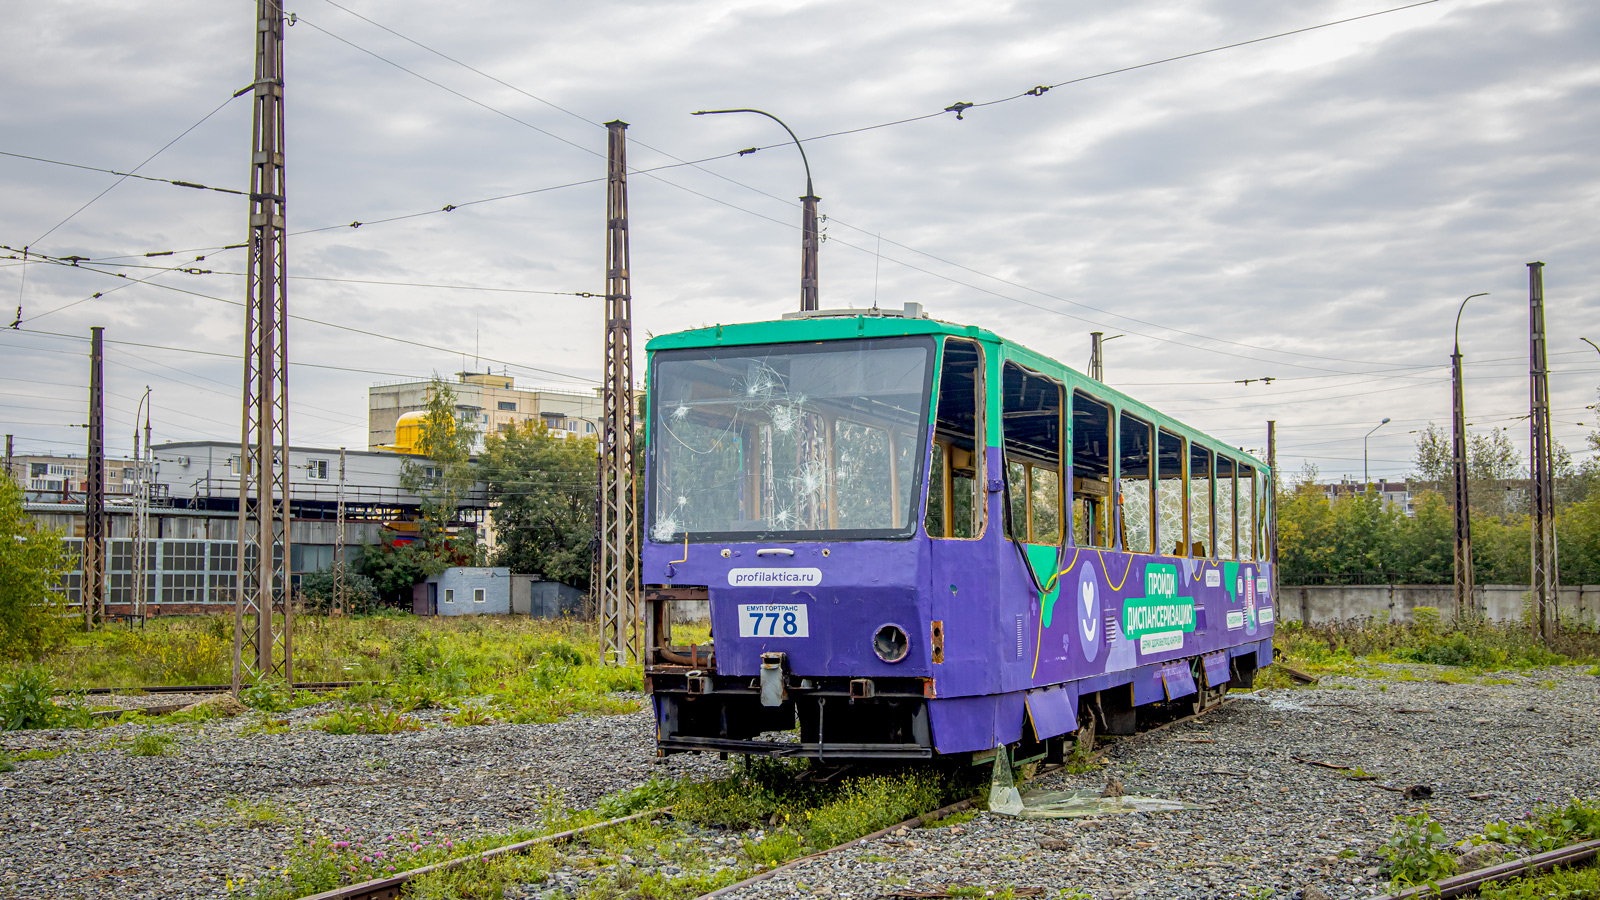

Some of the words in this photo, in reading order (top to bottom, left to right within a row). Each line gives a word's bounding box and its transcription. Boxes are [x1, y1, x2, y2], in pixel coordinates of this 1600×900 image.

[736, 572, 814, 583] profilaktica.ru
[1148, 567, 1175, 598] ПРОЙДИ
[749, 612, 798, 636] 778
[1127, 604, 1192, 635] ДИСПАНСЕРИЗАЦИЮ
